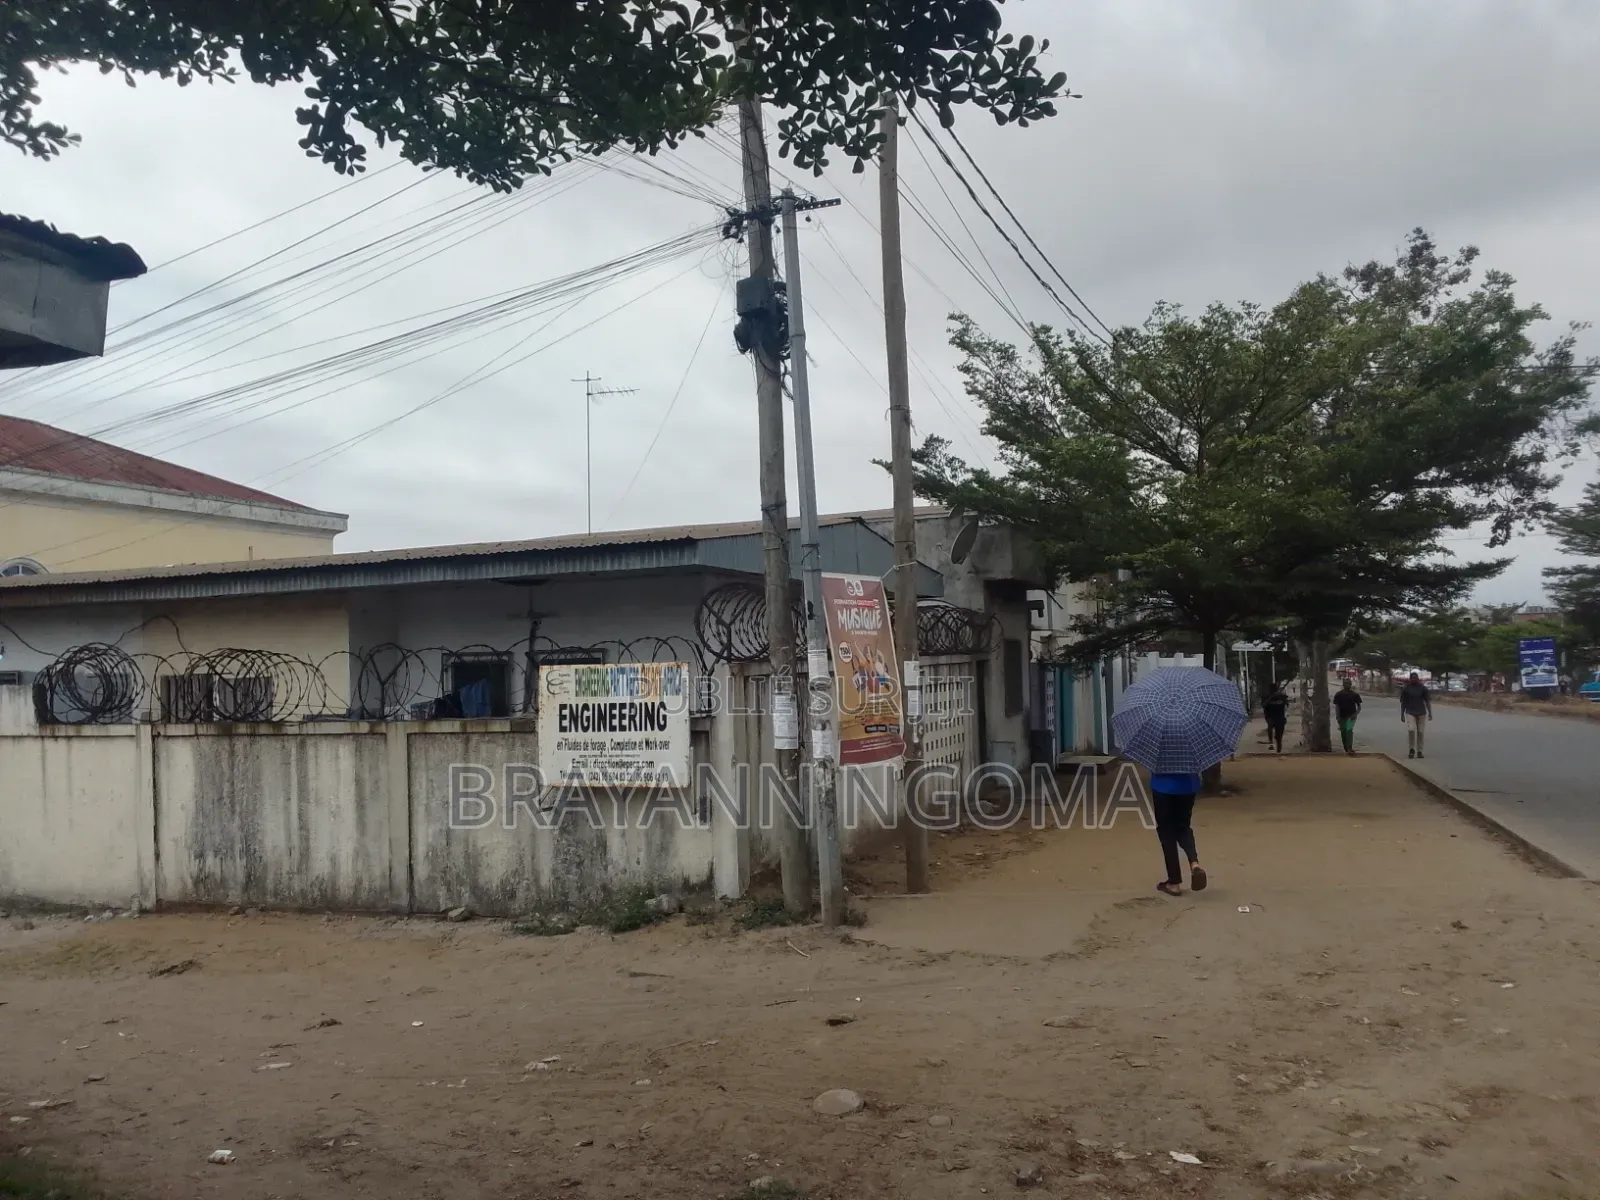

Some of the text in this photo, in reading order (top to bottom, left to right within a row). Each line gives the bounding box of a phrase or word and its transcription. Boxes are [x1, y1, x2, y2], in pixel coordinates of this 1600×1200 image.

[837, 608, 882, 632] MUSIQUE
[558, 701, 668, 732] ENGINEERING
[583, 739, 589, 751] de
[638, 739, 644, 751] et
